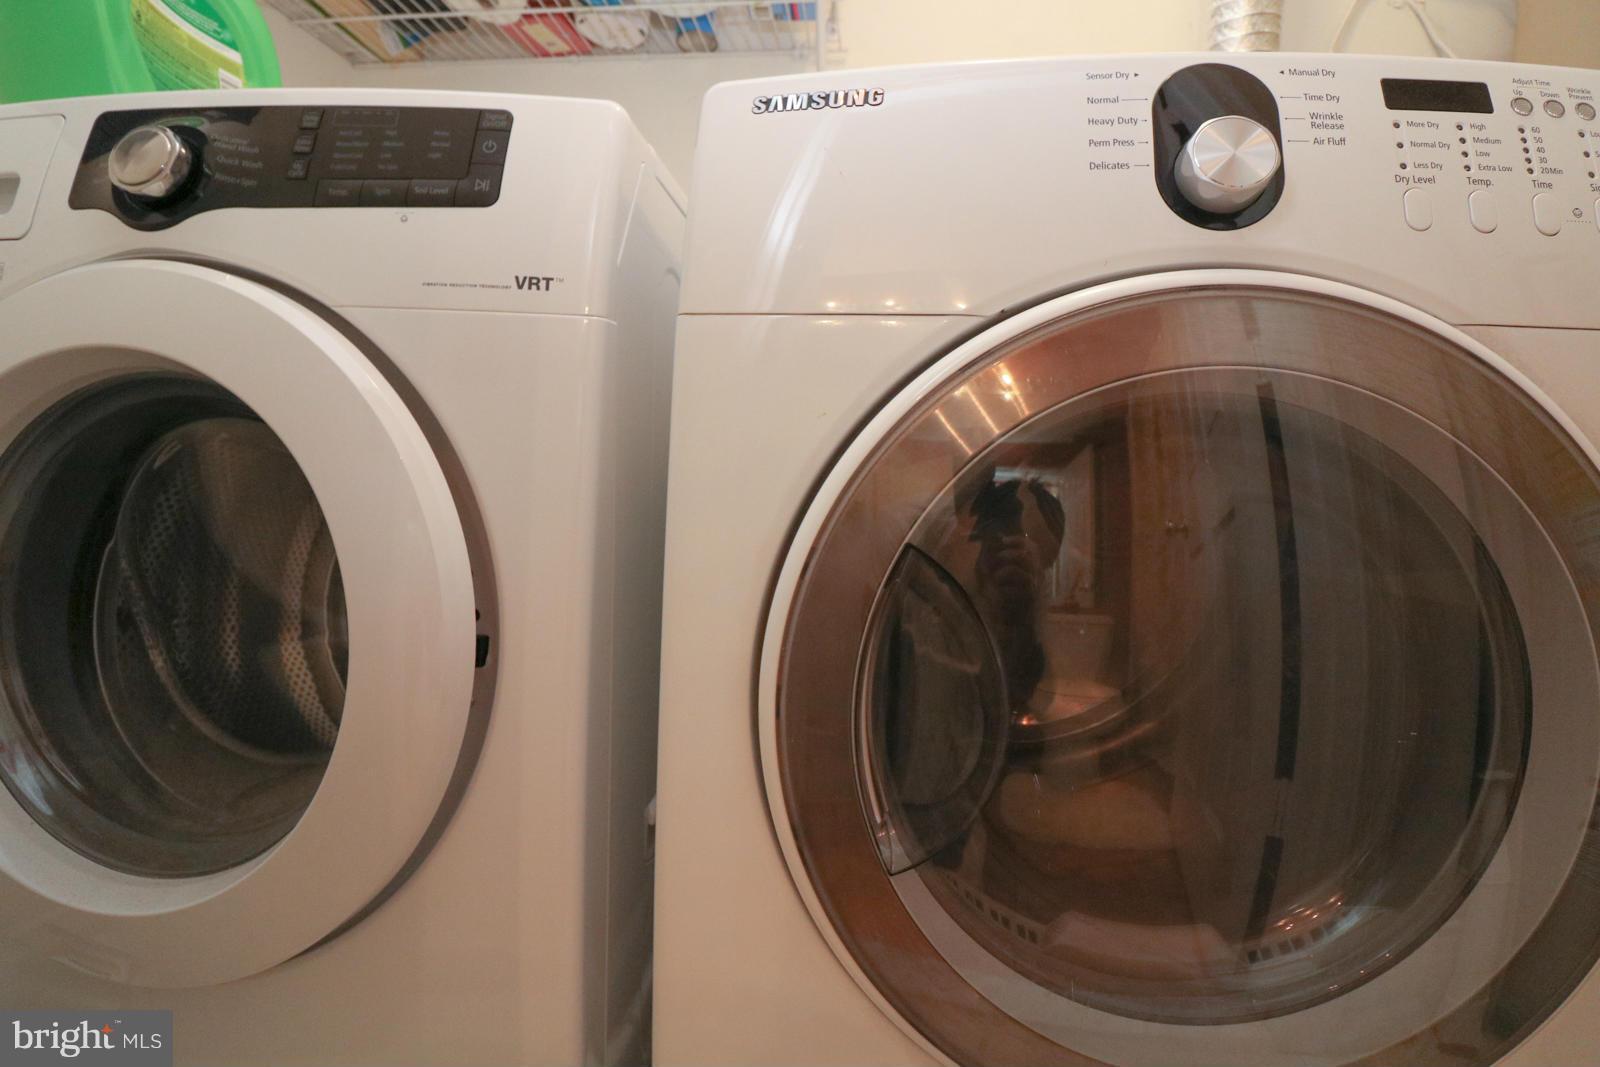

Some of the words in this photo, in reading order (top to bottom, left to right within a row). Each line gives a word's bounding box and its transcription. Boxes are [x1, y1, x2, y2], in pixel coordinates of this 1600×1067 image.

[1085, 71, 1111, 80] Sensor
[1113, 71, 1130, 80] Dry
[1288, 68, 1319, 77] Manual
[1321, 69, 1336, 78] Dry
[1512, 78, 1533, 87] Adjust
[1534, 79, 1551, 87] Time
[1512, 89, 1523, 97] Up
[1540, 91, 1560, 99] Down
[752, 88, 885, 114] SAMSUNG
[1087, 96, 1119, 105] Normal
[1304, 93, 1323, 102] Time
[1325, 94, 1340, 103] Dry
[1088, 117, 1115, 126] Heavy
[1117, 116, 1138, 126] Duty
[1309, 112, 1344, 121] Wrinkle
[1310, 121, 1345, 130] Release
[1406, 120, 1426, 128] More
[1427, 121, 1440, 129] Dry
[1470, 123, 1486, 131] High
[1088, 139, 1112, 147] Perm
[1113, 139, 1135, 147] Press
[1313, 137, 1325, 145] Air
[1327, 137, 1346, 146] Fluff
[1437, 142, 1450, 150] Dry
[1089, 161, 1130, 170] Delicates
[1430, 162, 1443, 170] Dry
[1478, 164, 1496, 172] Extra
[1394, 175, 1410, 185] Dry
[1412, 175, 1436, 184] Level
[1466, 177, 1494, 187] Temp.
[1532, 180, 1553, 189] Time
[514, 275, 554, 291] VRT
